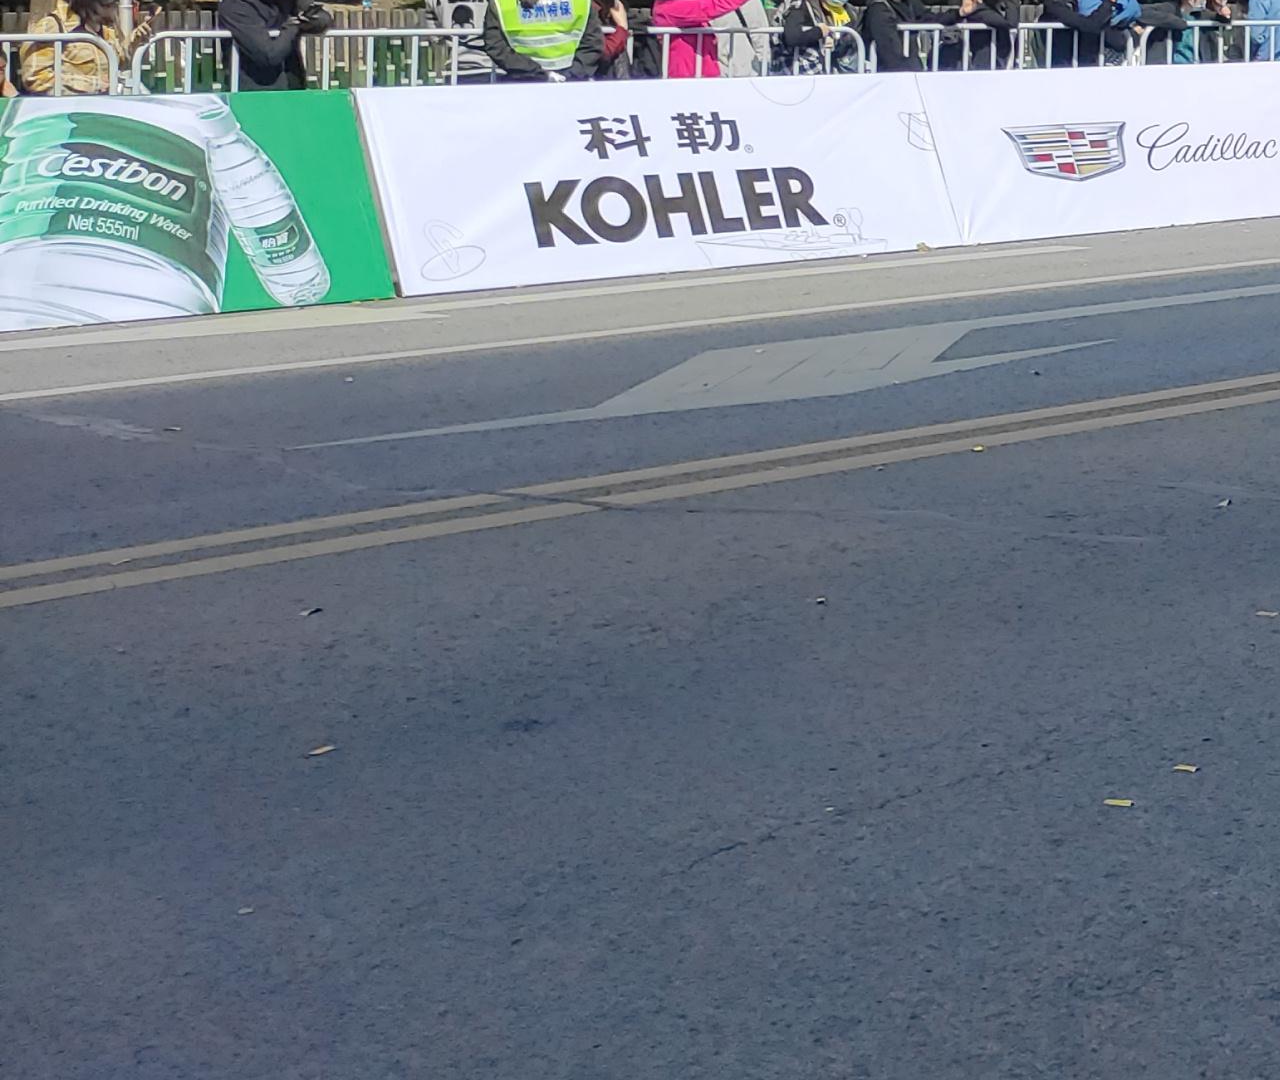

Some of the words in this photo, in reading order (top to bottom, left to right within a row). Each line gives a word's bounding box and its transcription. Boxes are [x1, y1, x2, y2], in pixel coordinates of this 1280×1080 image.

[577, 111, 741, 160] 科勒
[1137, 121, 1278, 173] Cadillac
[15, 196, 77, 214] Purified
[80, 197, 149, 224] Drinking
[149, 211, 193, 241] Water
[67, 214, 95, 232] Net
[96, 217, 140, 241] 555ml
[523, 166, 830, 249] KOHLER
